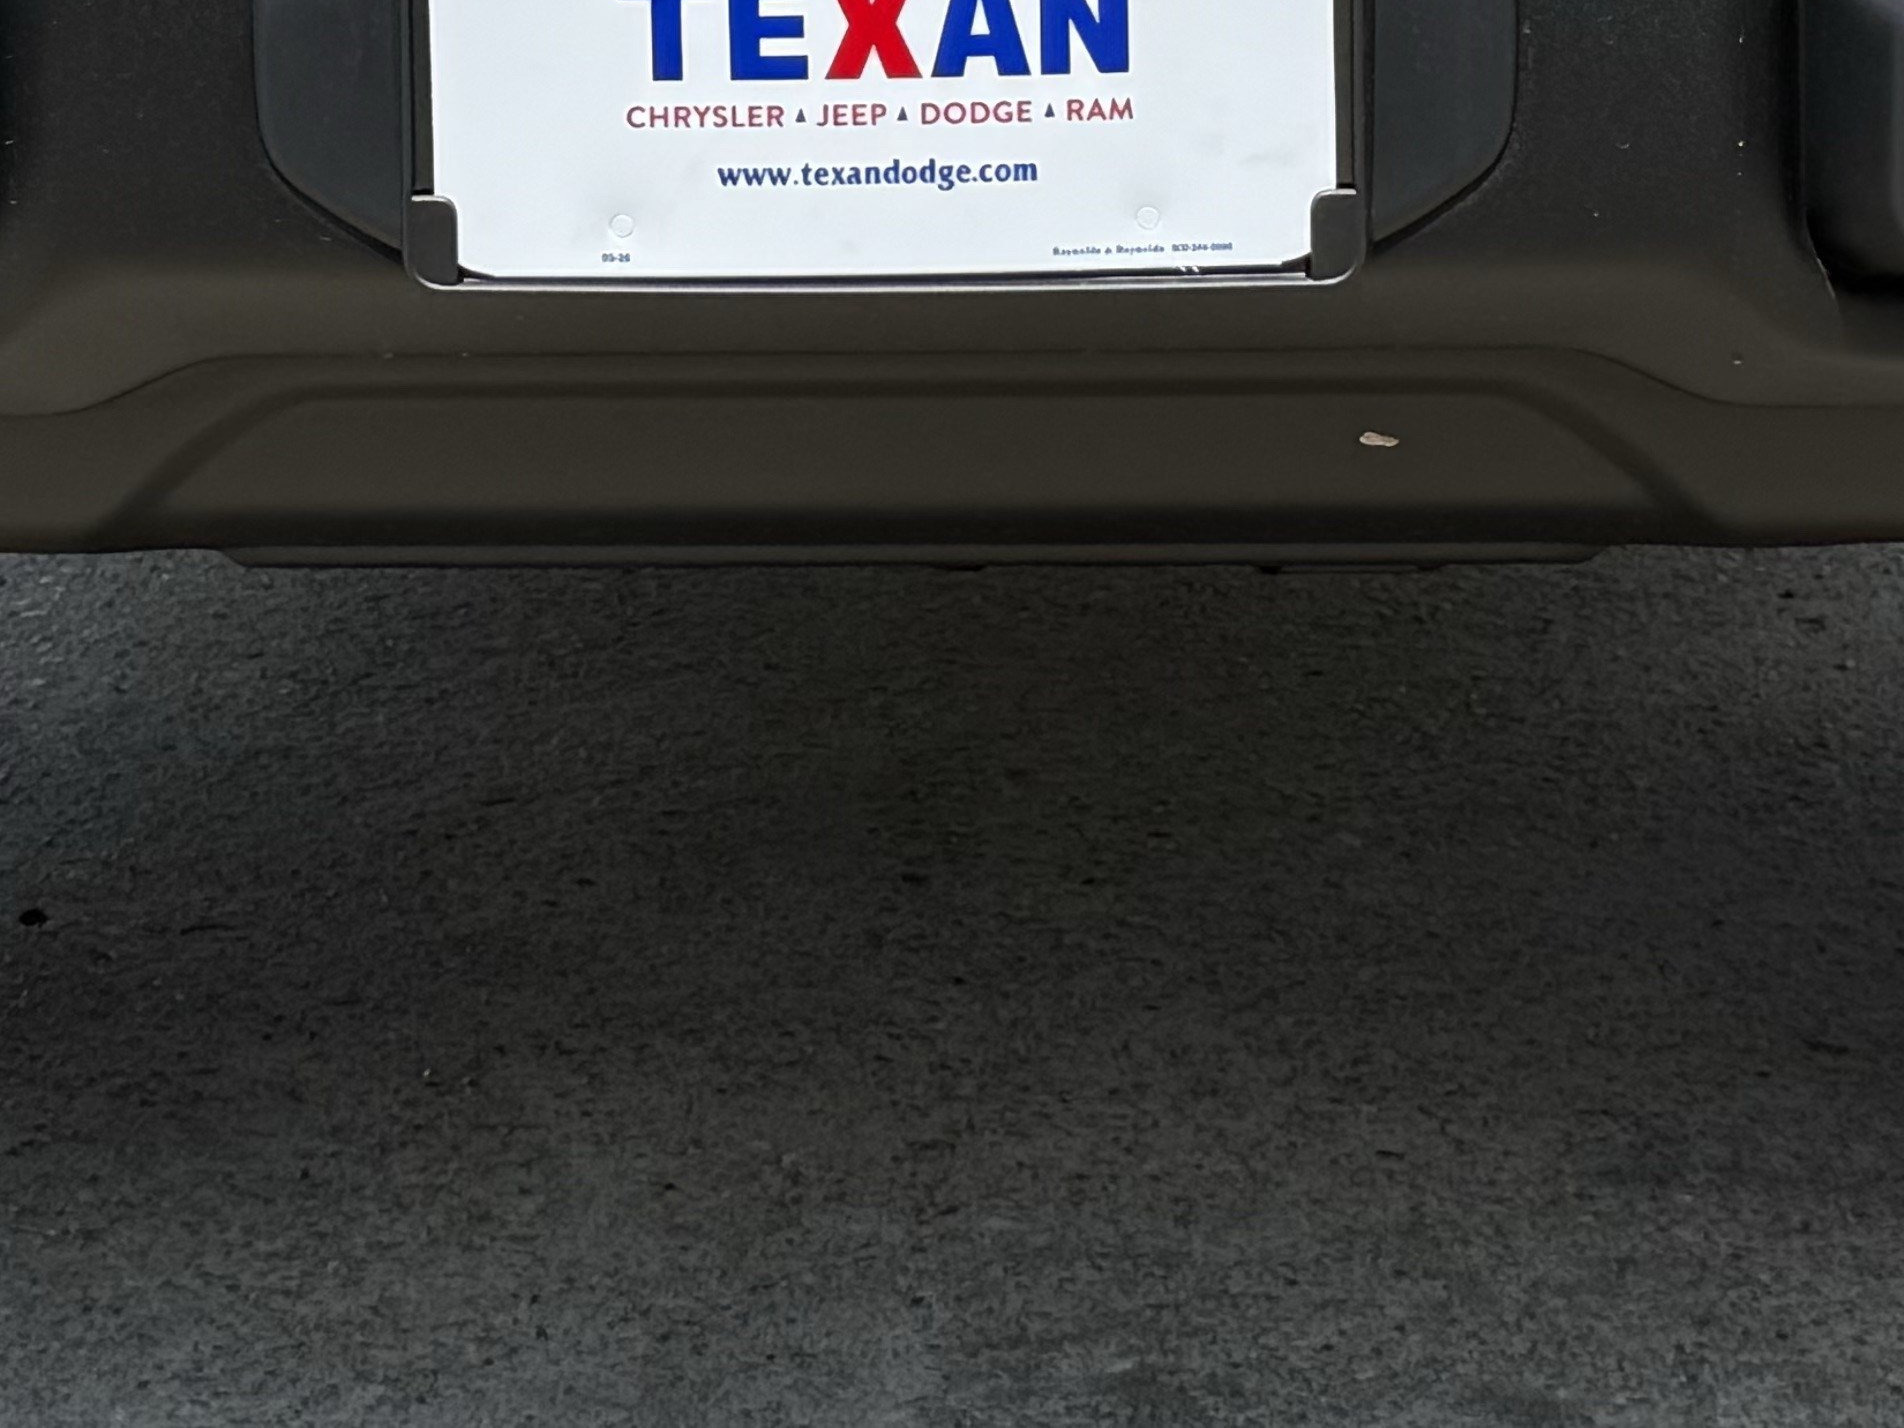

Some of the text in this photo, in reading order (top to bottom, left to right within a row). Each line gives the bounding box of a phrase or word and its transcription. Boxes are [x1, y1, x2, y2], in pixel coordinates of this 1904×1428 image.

[625, 96, 1135, 131] CHRYSLER JEEP DODGE RAM
[717, 158, 1039, 192] www.texandodge.com
